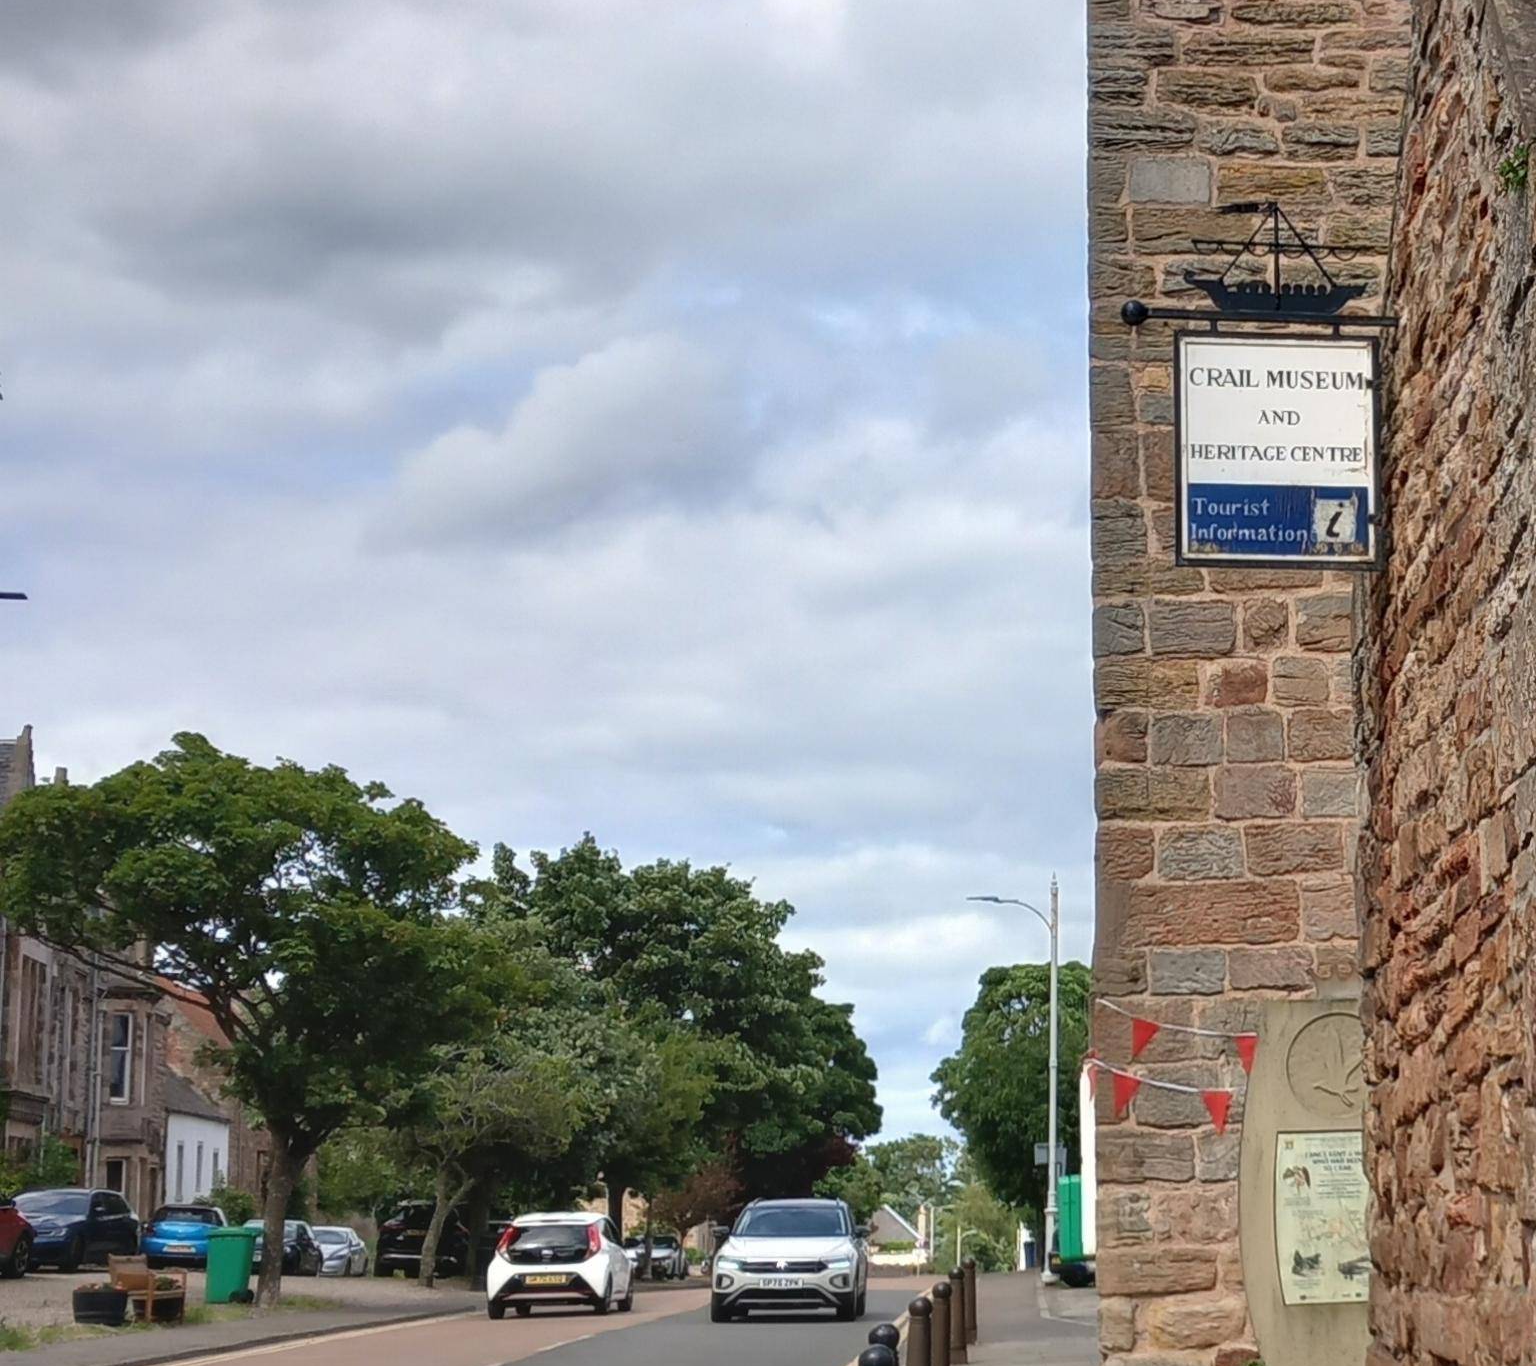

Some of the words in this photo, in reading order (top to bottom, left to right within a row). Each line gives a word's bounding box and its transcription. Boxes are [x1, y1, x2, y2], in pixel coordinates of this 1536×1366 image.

[1189, 367, 1260, 388] CRAIL
[1266, 370, 1365, 390] MUSEUM
[1258, 409, 1301, 426] AND
[1190, 443, 1288, 461] HERITAGE
[1290, 446, 1363, 462] CENTRE
[1191, 497, 1271, 516] Tourist
[1190, 522, 1308, 542] Information
